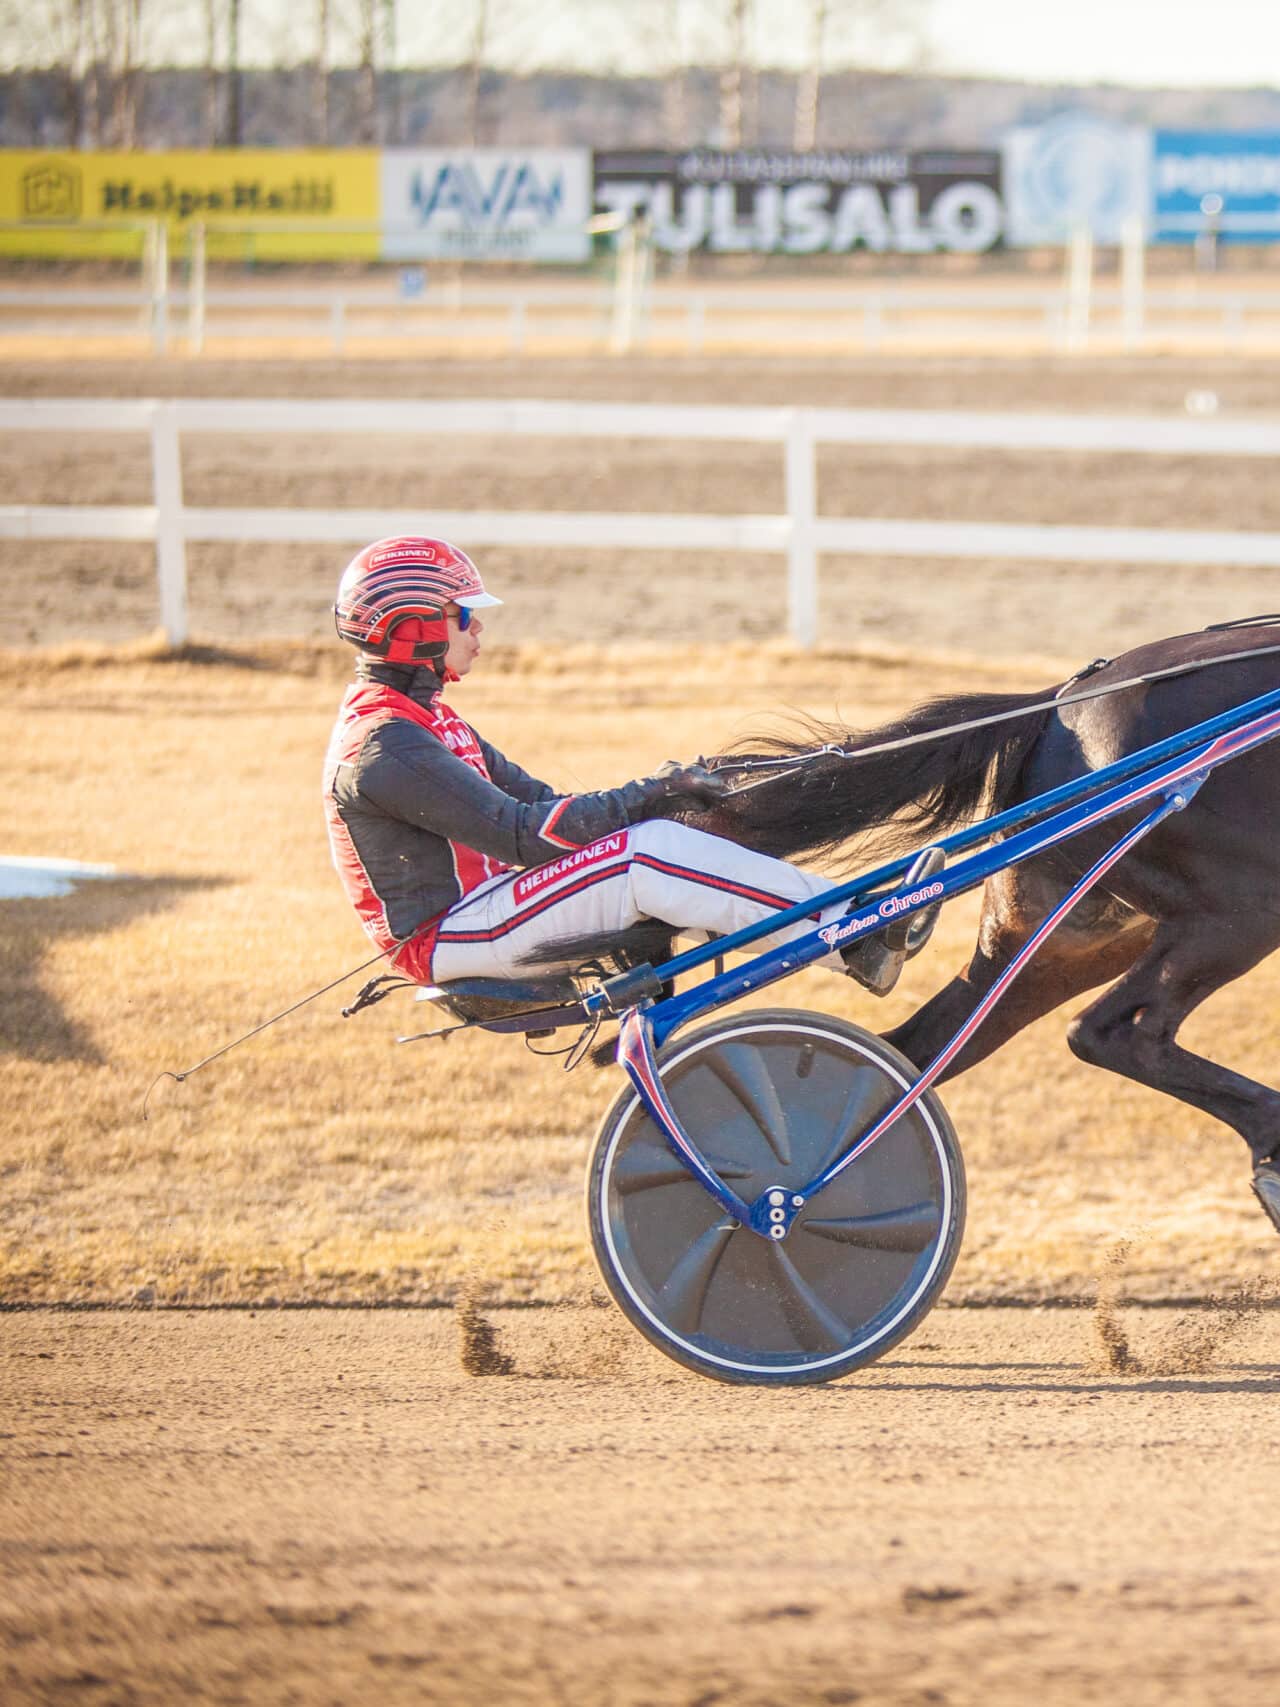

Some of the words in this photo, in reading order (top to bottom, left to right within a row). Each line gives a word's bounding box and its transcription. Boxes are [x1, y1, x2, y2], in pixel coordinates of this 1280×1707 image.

[597, 181, 1001, 252] TULISALO
[519, 836, 621, 896] HEIKKINEN
[818, 913, 880, 945] Custom
[879, 882, 944, 918] Chrono
